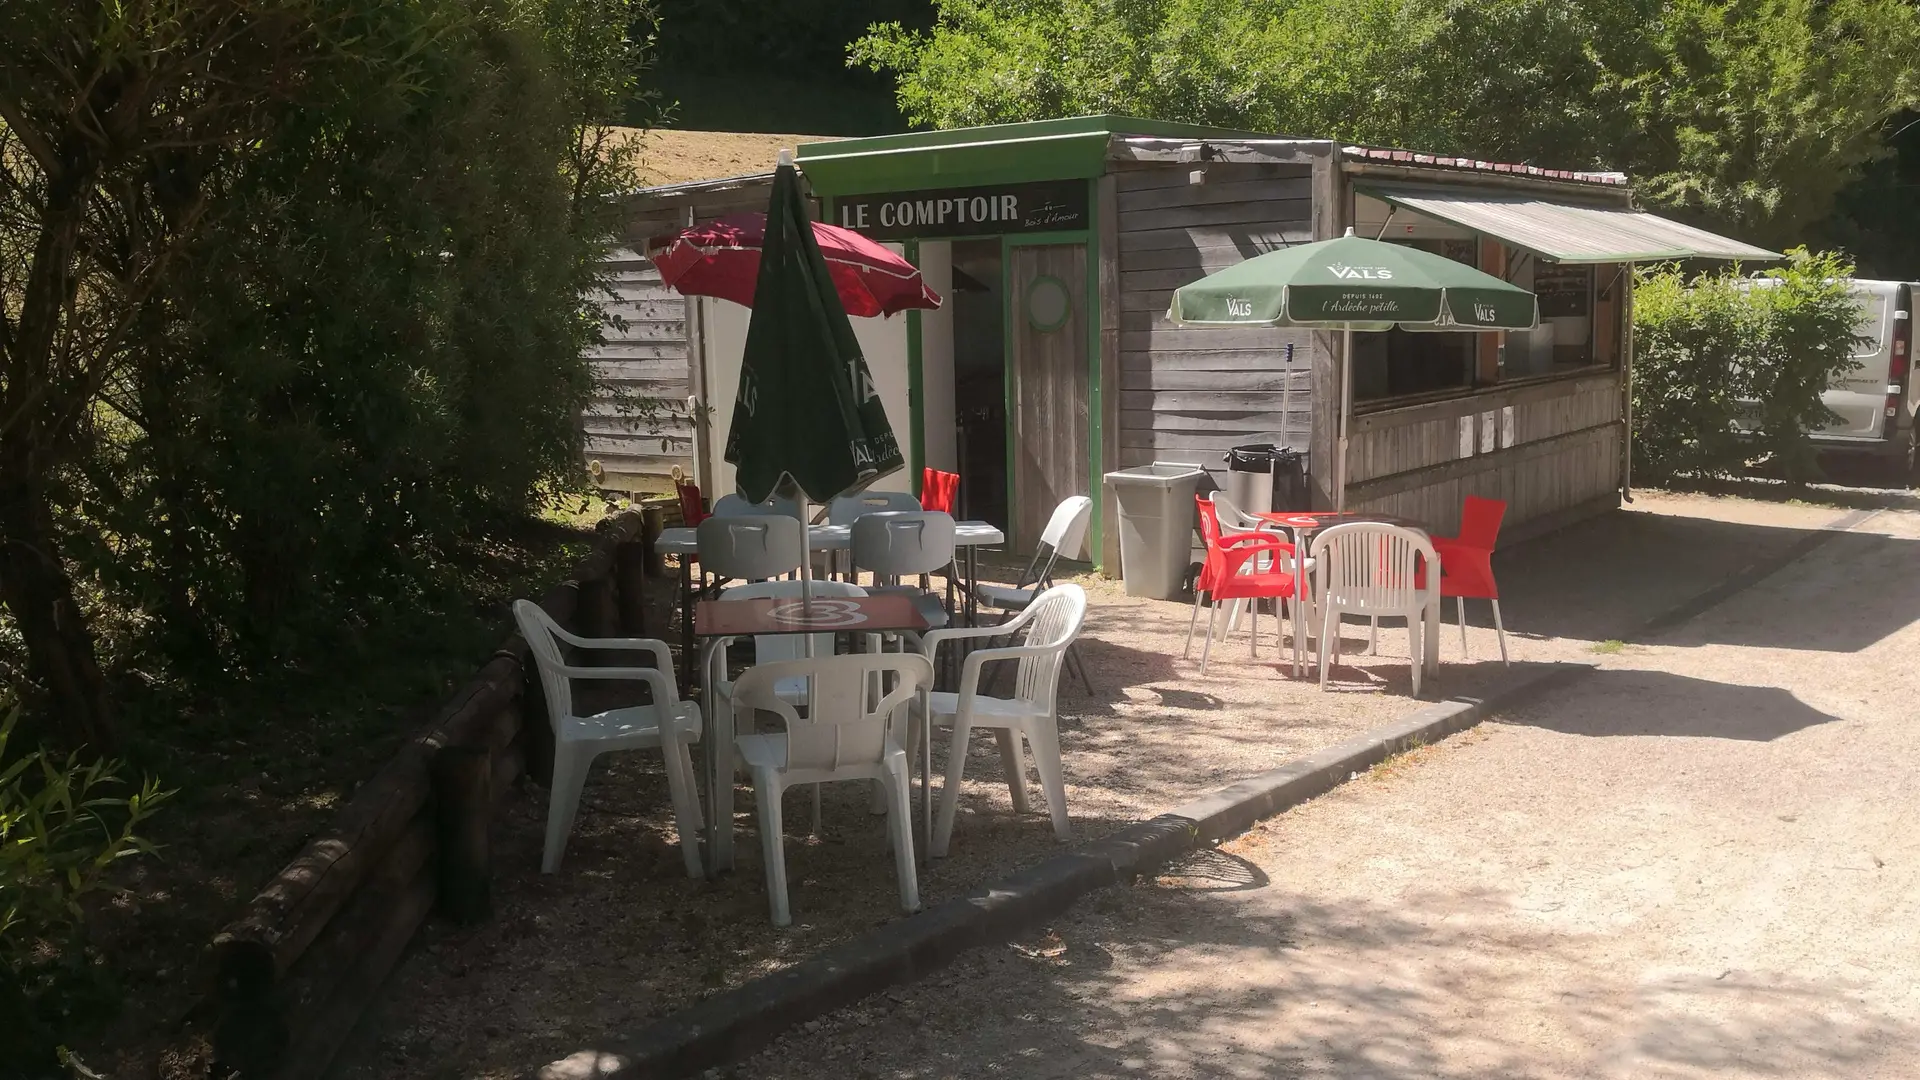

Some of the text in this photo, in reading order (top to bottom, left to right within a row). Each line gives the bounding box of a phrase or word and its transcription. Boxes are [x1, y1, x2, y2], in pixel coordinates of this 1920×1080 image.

[842, 195, 1018, 229] LE COMPTOIR
[1024, 218, 1042, 227] Bois
[1326, 266, 1393, 279] VALS
[1226, 298, 1252, 316] VALS
[1474, 303, 1496, 322] VALS
